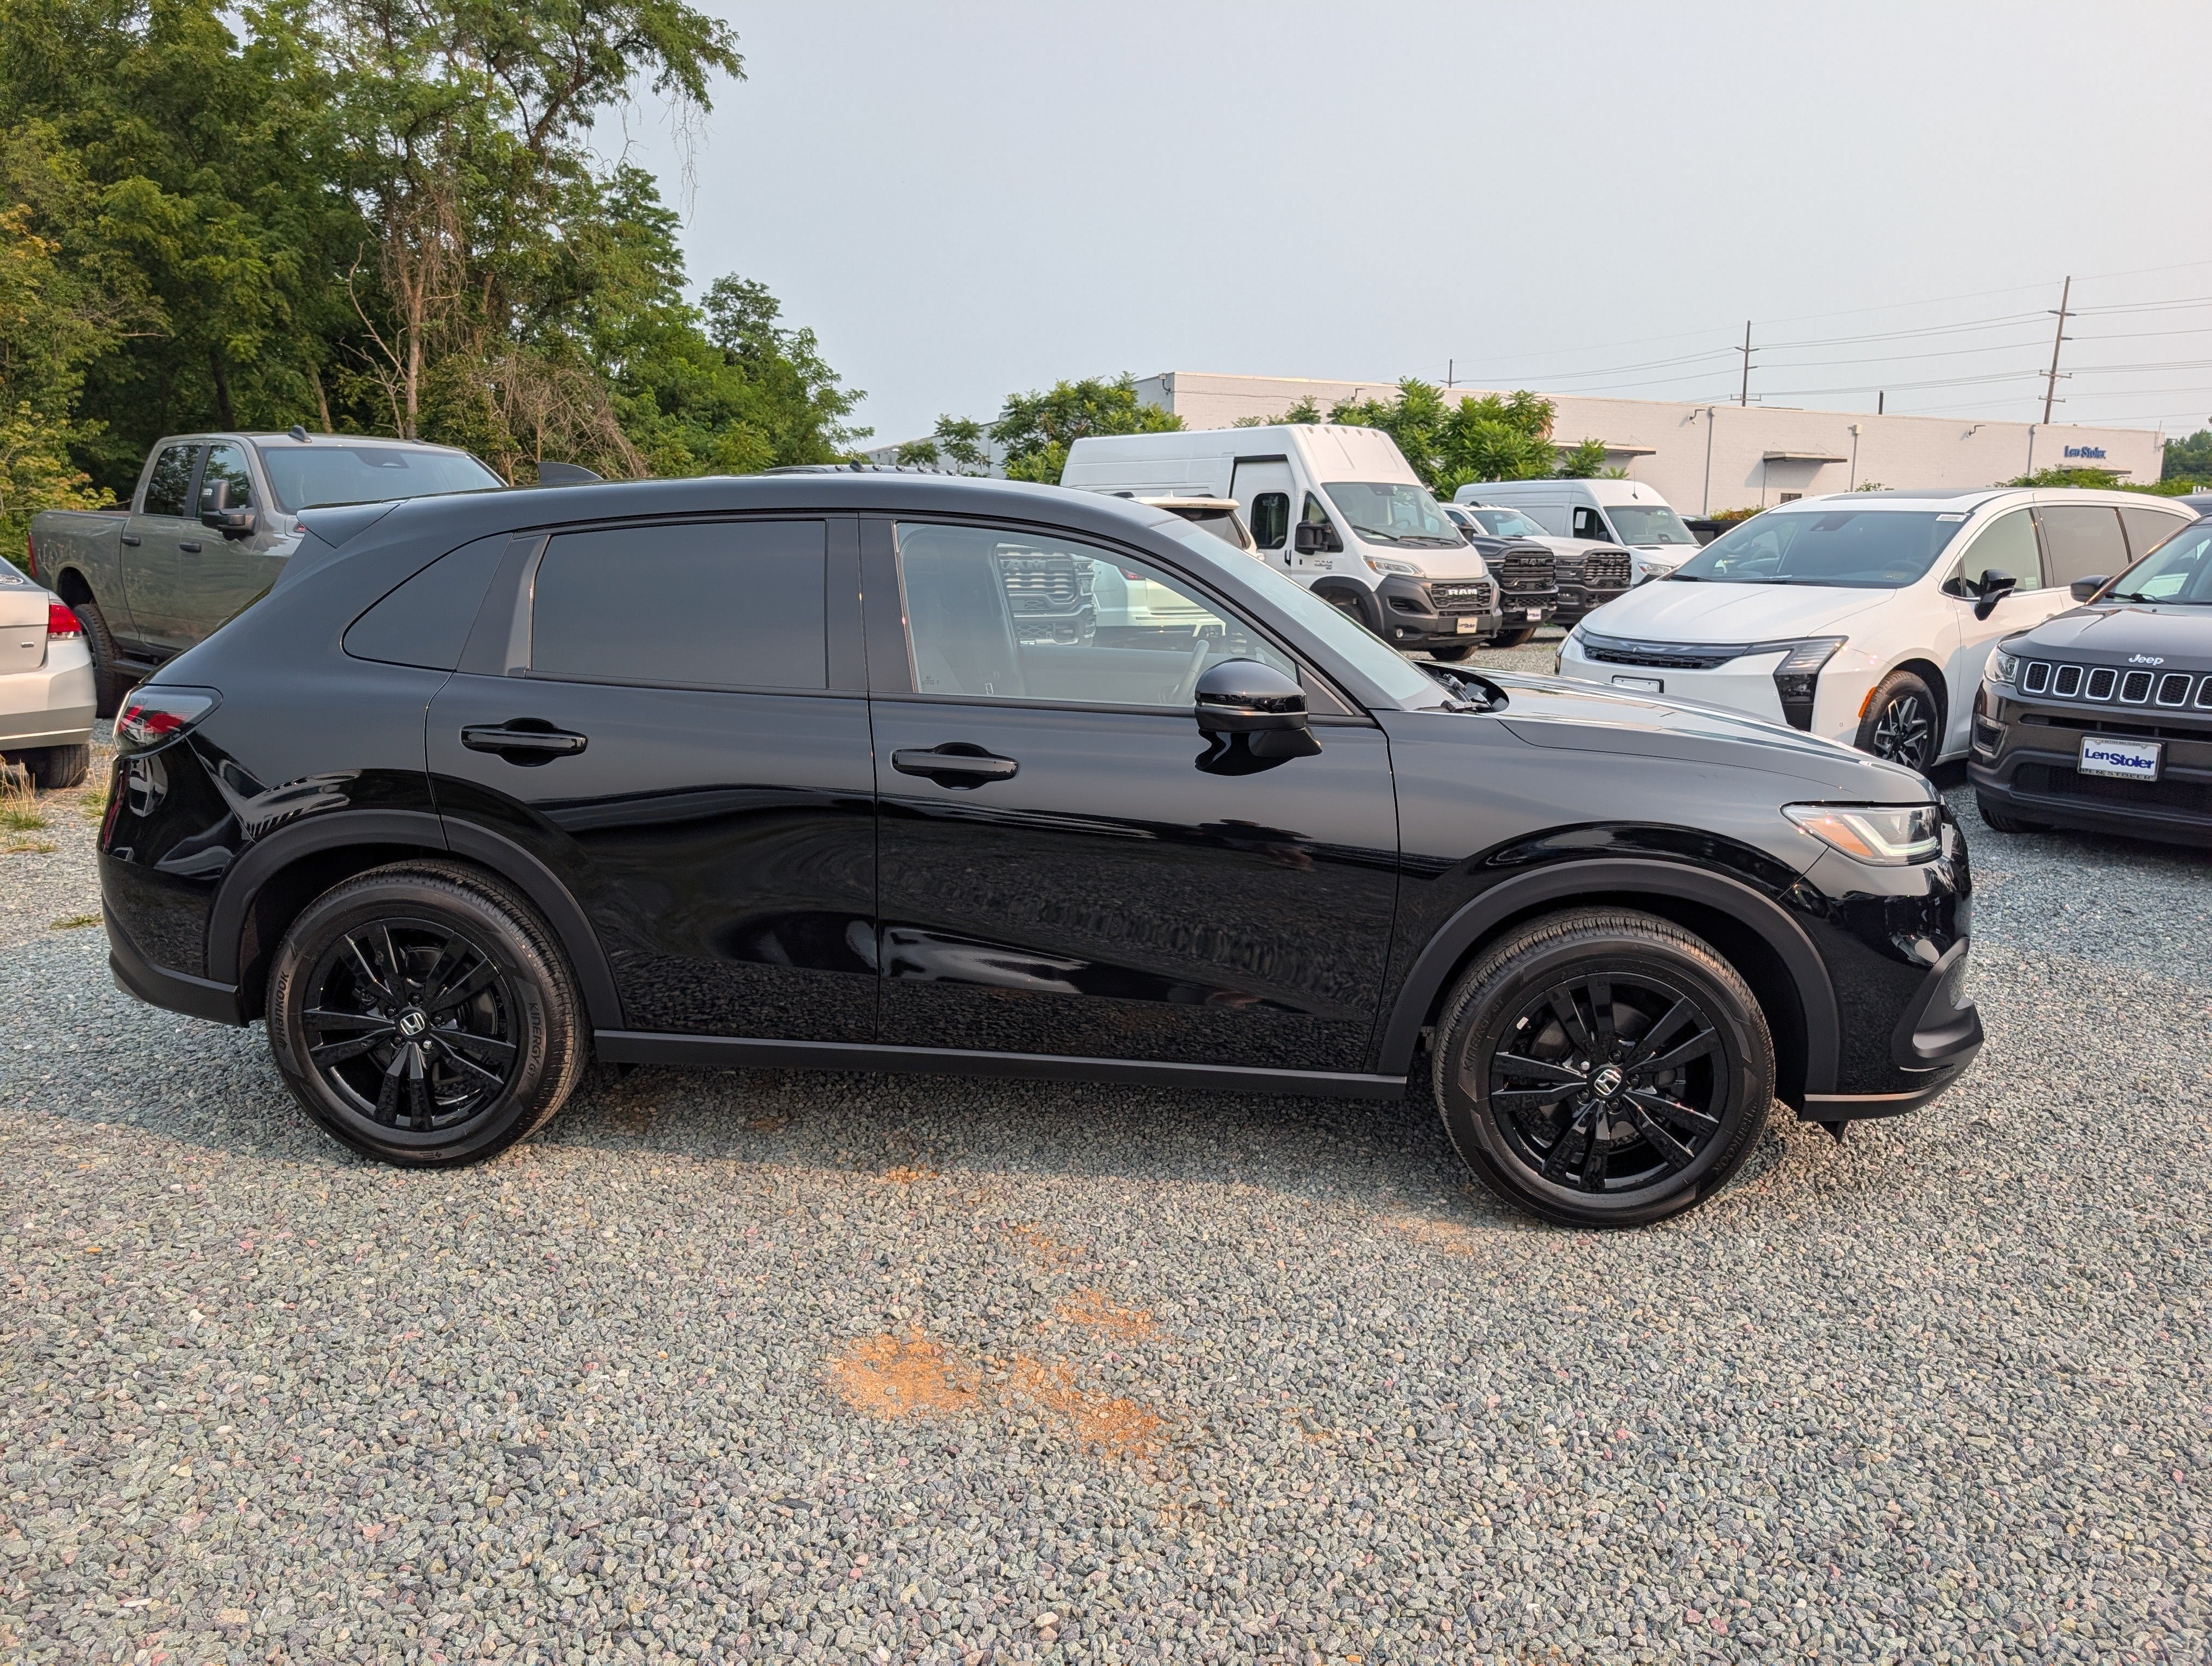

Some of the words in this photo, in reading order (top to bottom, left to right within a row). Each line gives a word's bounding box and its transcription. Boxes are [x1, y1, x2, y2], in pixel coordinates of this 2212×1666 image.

[1001, 560, 1048, 570] AM
[2128, 653, 2164, 666] Jeep
[2107, 771, 2152, 780] STOLER
